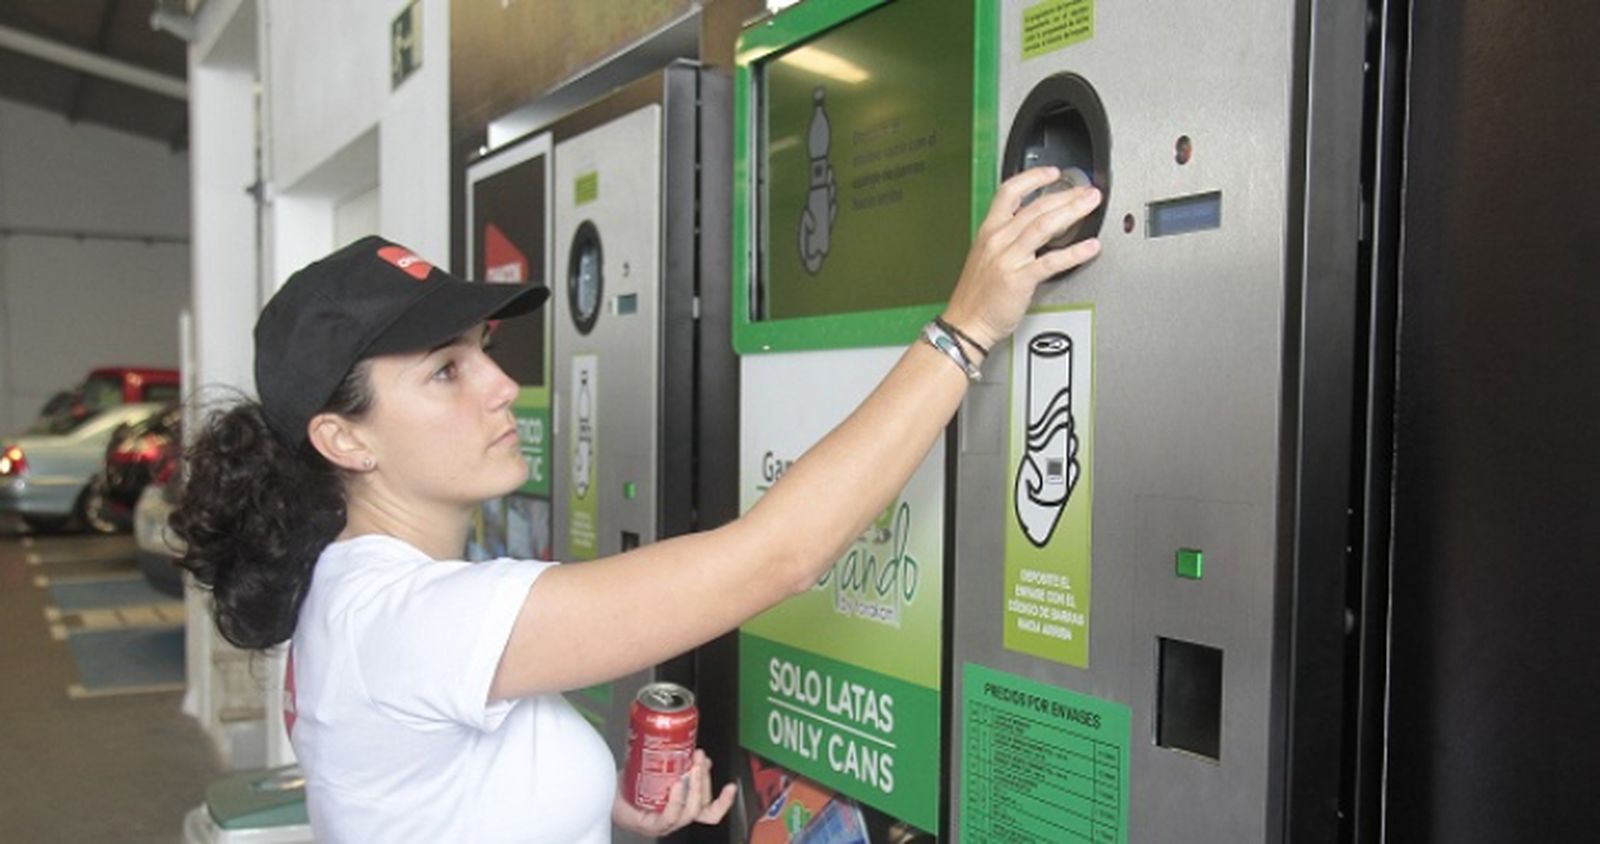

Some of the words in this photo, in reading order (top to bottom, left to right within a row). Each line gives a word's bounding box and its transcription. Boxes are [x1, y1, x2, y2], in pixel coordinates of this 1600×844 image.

[1060, 575, 1071, 589] EL
[1015, 583, 1045, 603] ENVASE
[1046, 590, 1065, 606] CON
[1066, 593, 1076, 608] EL
[1039, 605, 1050, 619] DE
[1050, 607, 1084, 626] BARRAS
[1018, 617, 1041, 634] HACIA
[1042, 623, 1072, 641] ARRIBA
[769, 657, 822, 706] SOLO
[826, 675, 893, 733] LATAS
[984, 682, 1026, 708] PRECIOS
[1028, 695, 1049, 713] POR
[1051, 701, 1102, 730] ENVASES
[768, 710, 823, 761] ONLY
[828, 734, 894, 793] CANS
